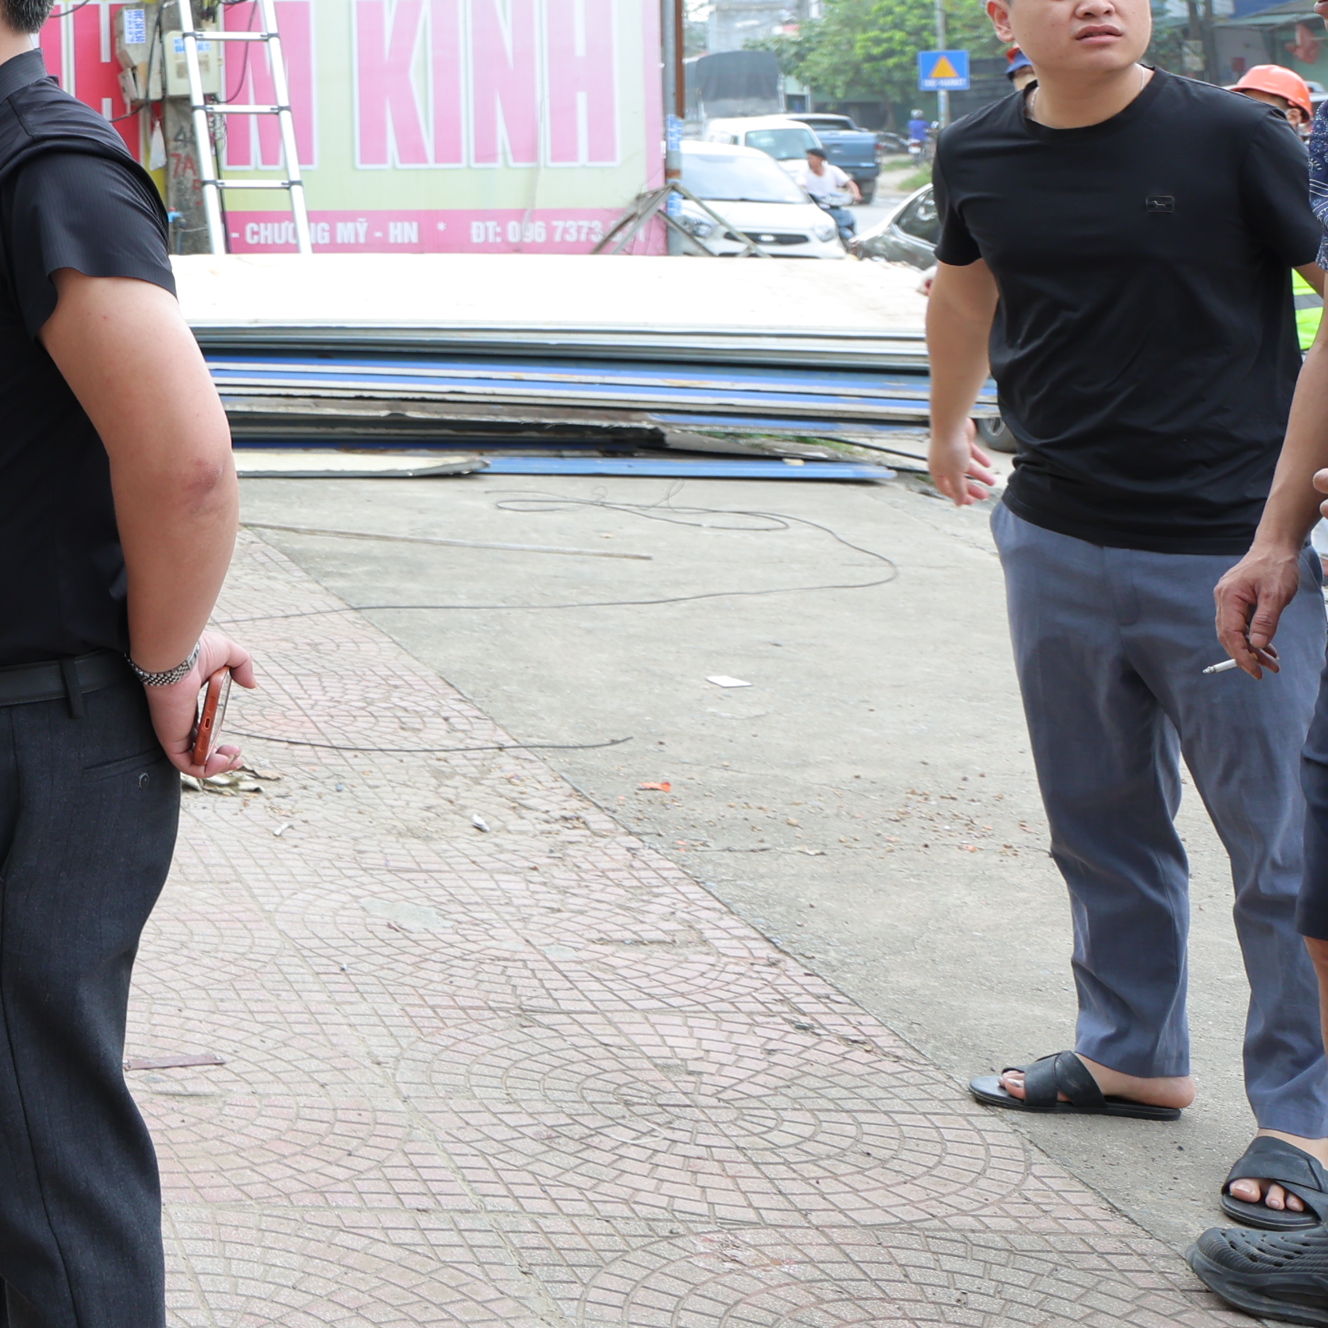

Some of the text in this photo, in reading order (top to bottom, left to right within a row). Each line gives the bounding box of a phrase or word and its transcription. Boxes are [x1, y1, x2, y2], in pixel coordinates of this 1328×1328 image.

[336, 217, 369, 244] MỸ
[389, 222, 419, 244] HN
[470, 221, 502, 243] ĐT:
[507, 221, 546, 243] 096
[552, 221, 604, 243] 7373
